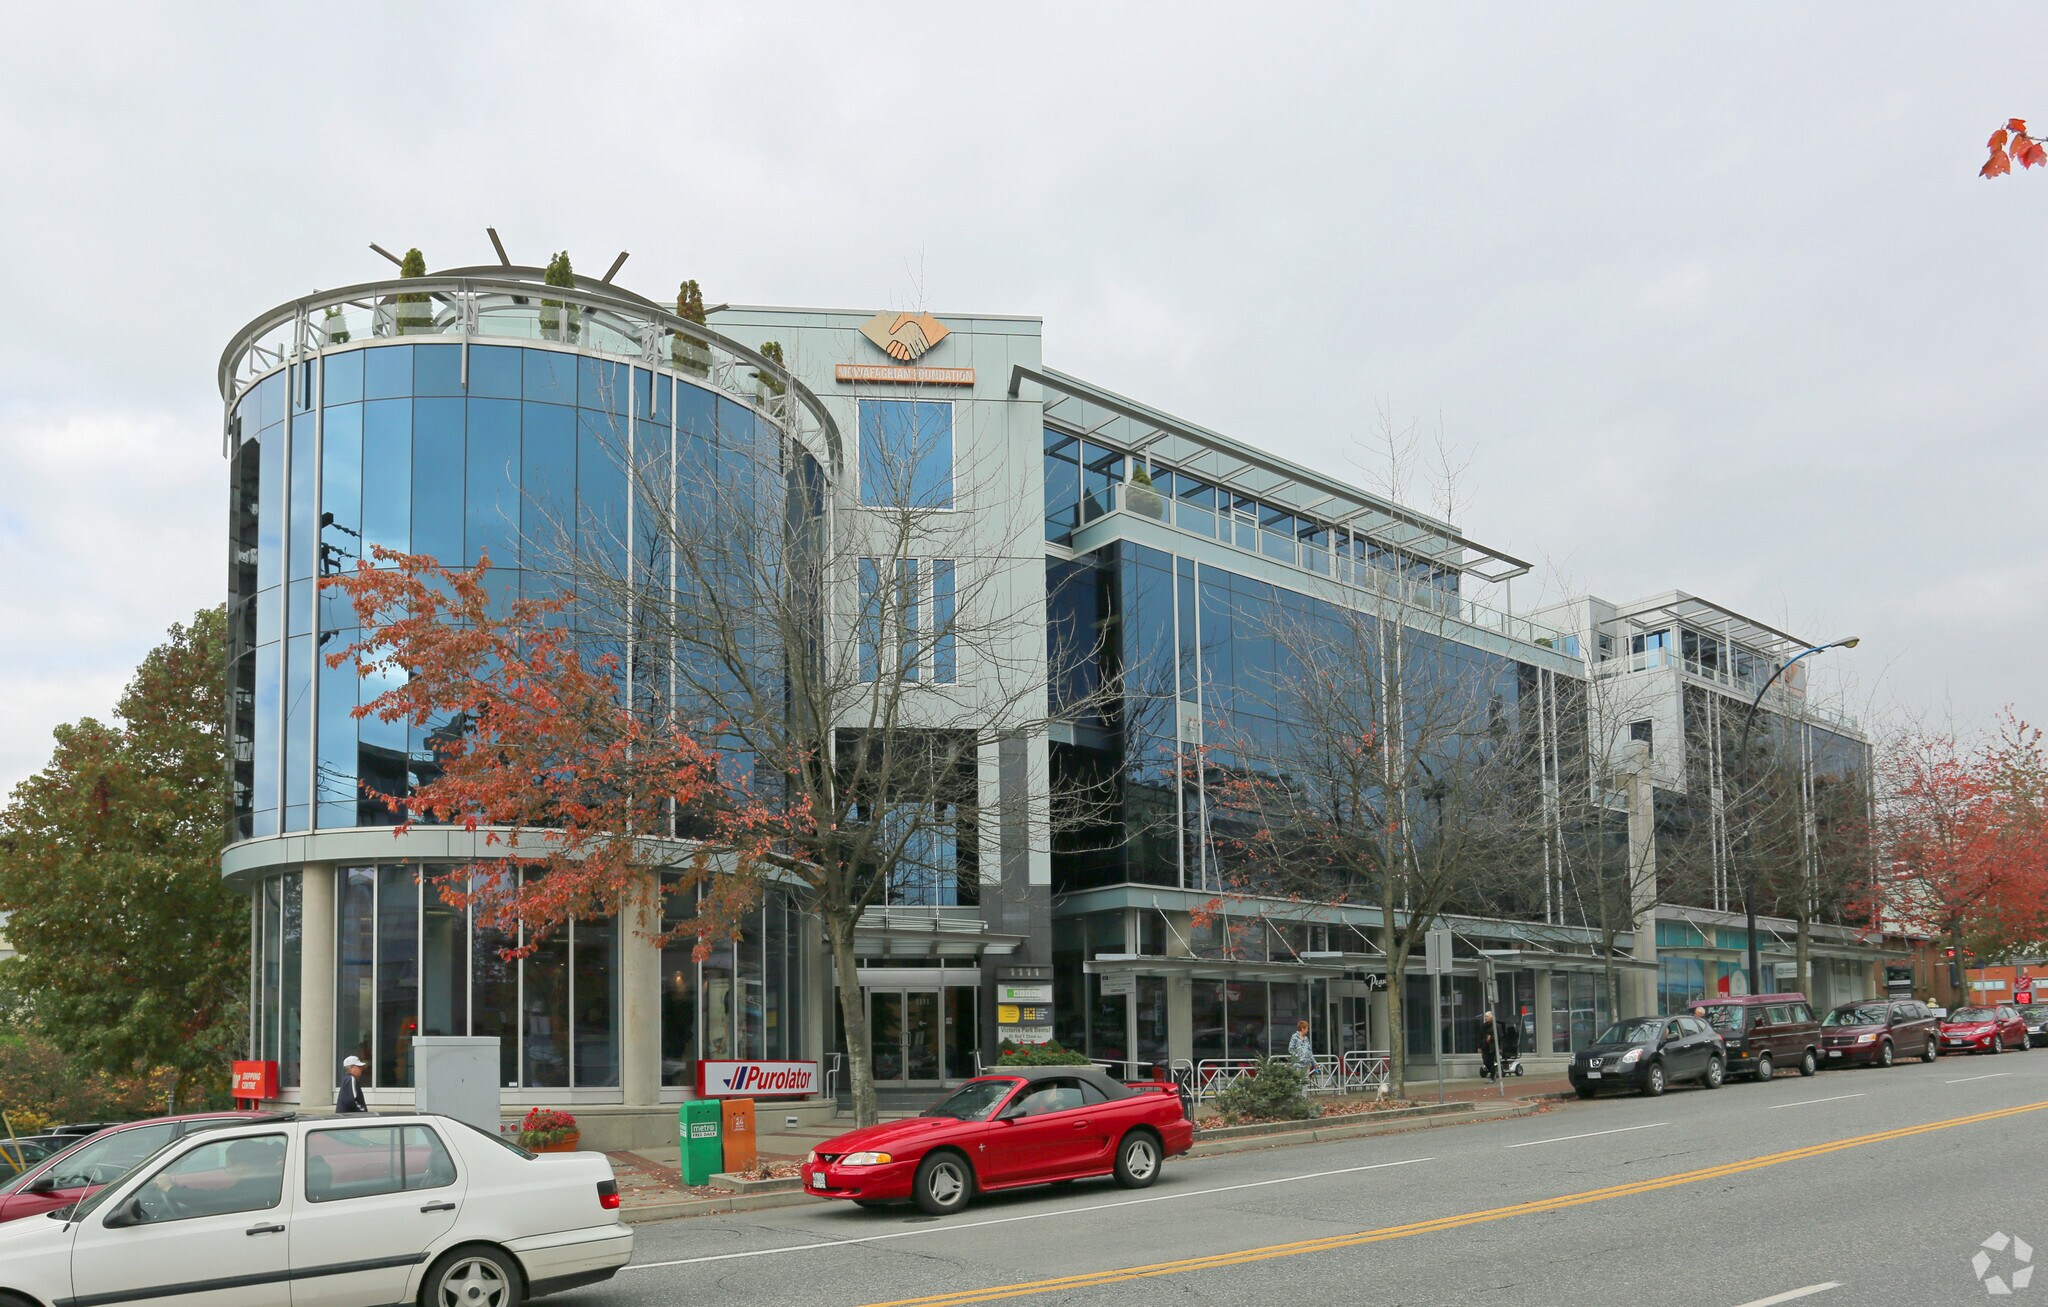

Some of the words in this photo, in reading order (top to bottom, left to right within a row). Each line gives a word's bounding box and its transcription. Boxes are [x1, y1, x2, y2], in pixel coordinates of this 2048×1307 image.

[914, 368, 972, 381] FOUNDATION
[1009, 968, 1039, 976] 1111
[242, 1072, 261, 1080] SHIPPING
[745, 1066, 812, 1090] Purolator
[242, 1081, 256, 1089] CENTRE
[693, 1124, 715, 1132] metro
